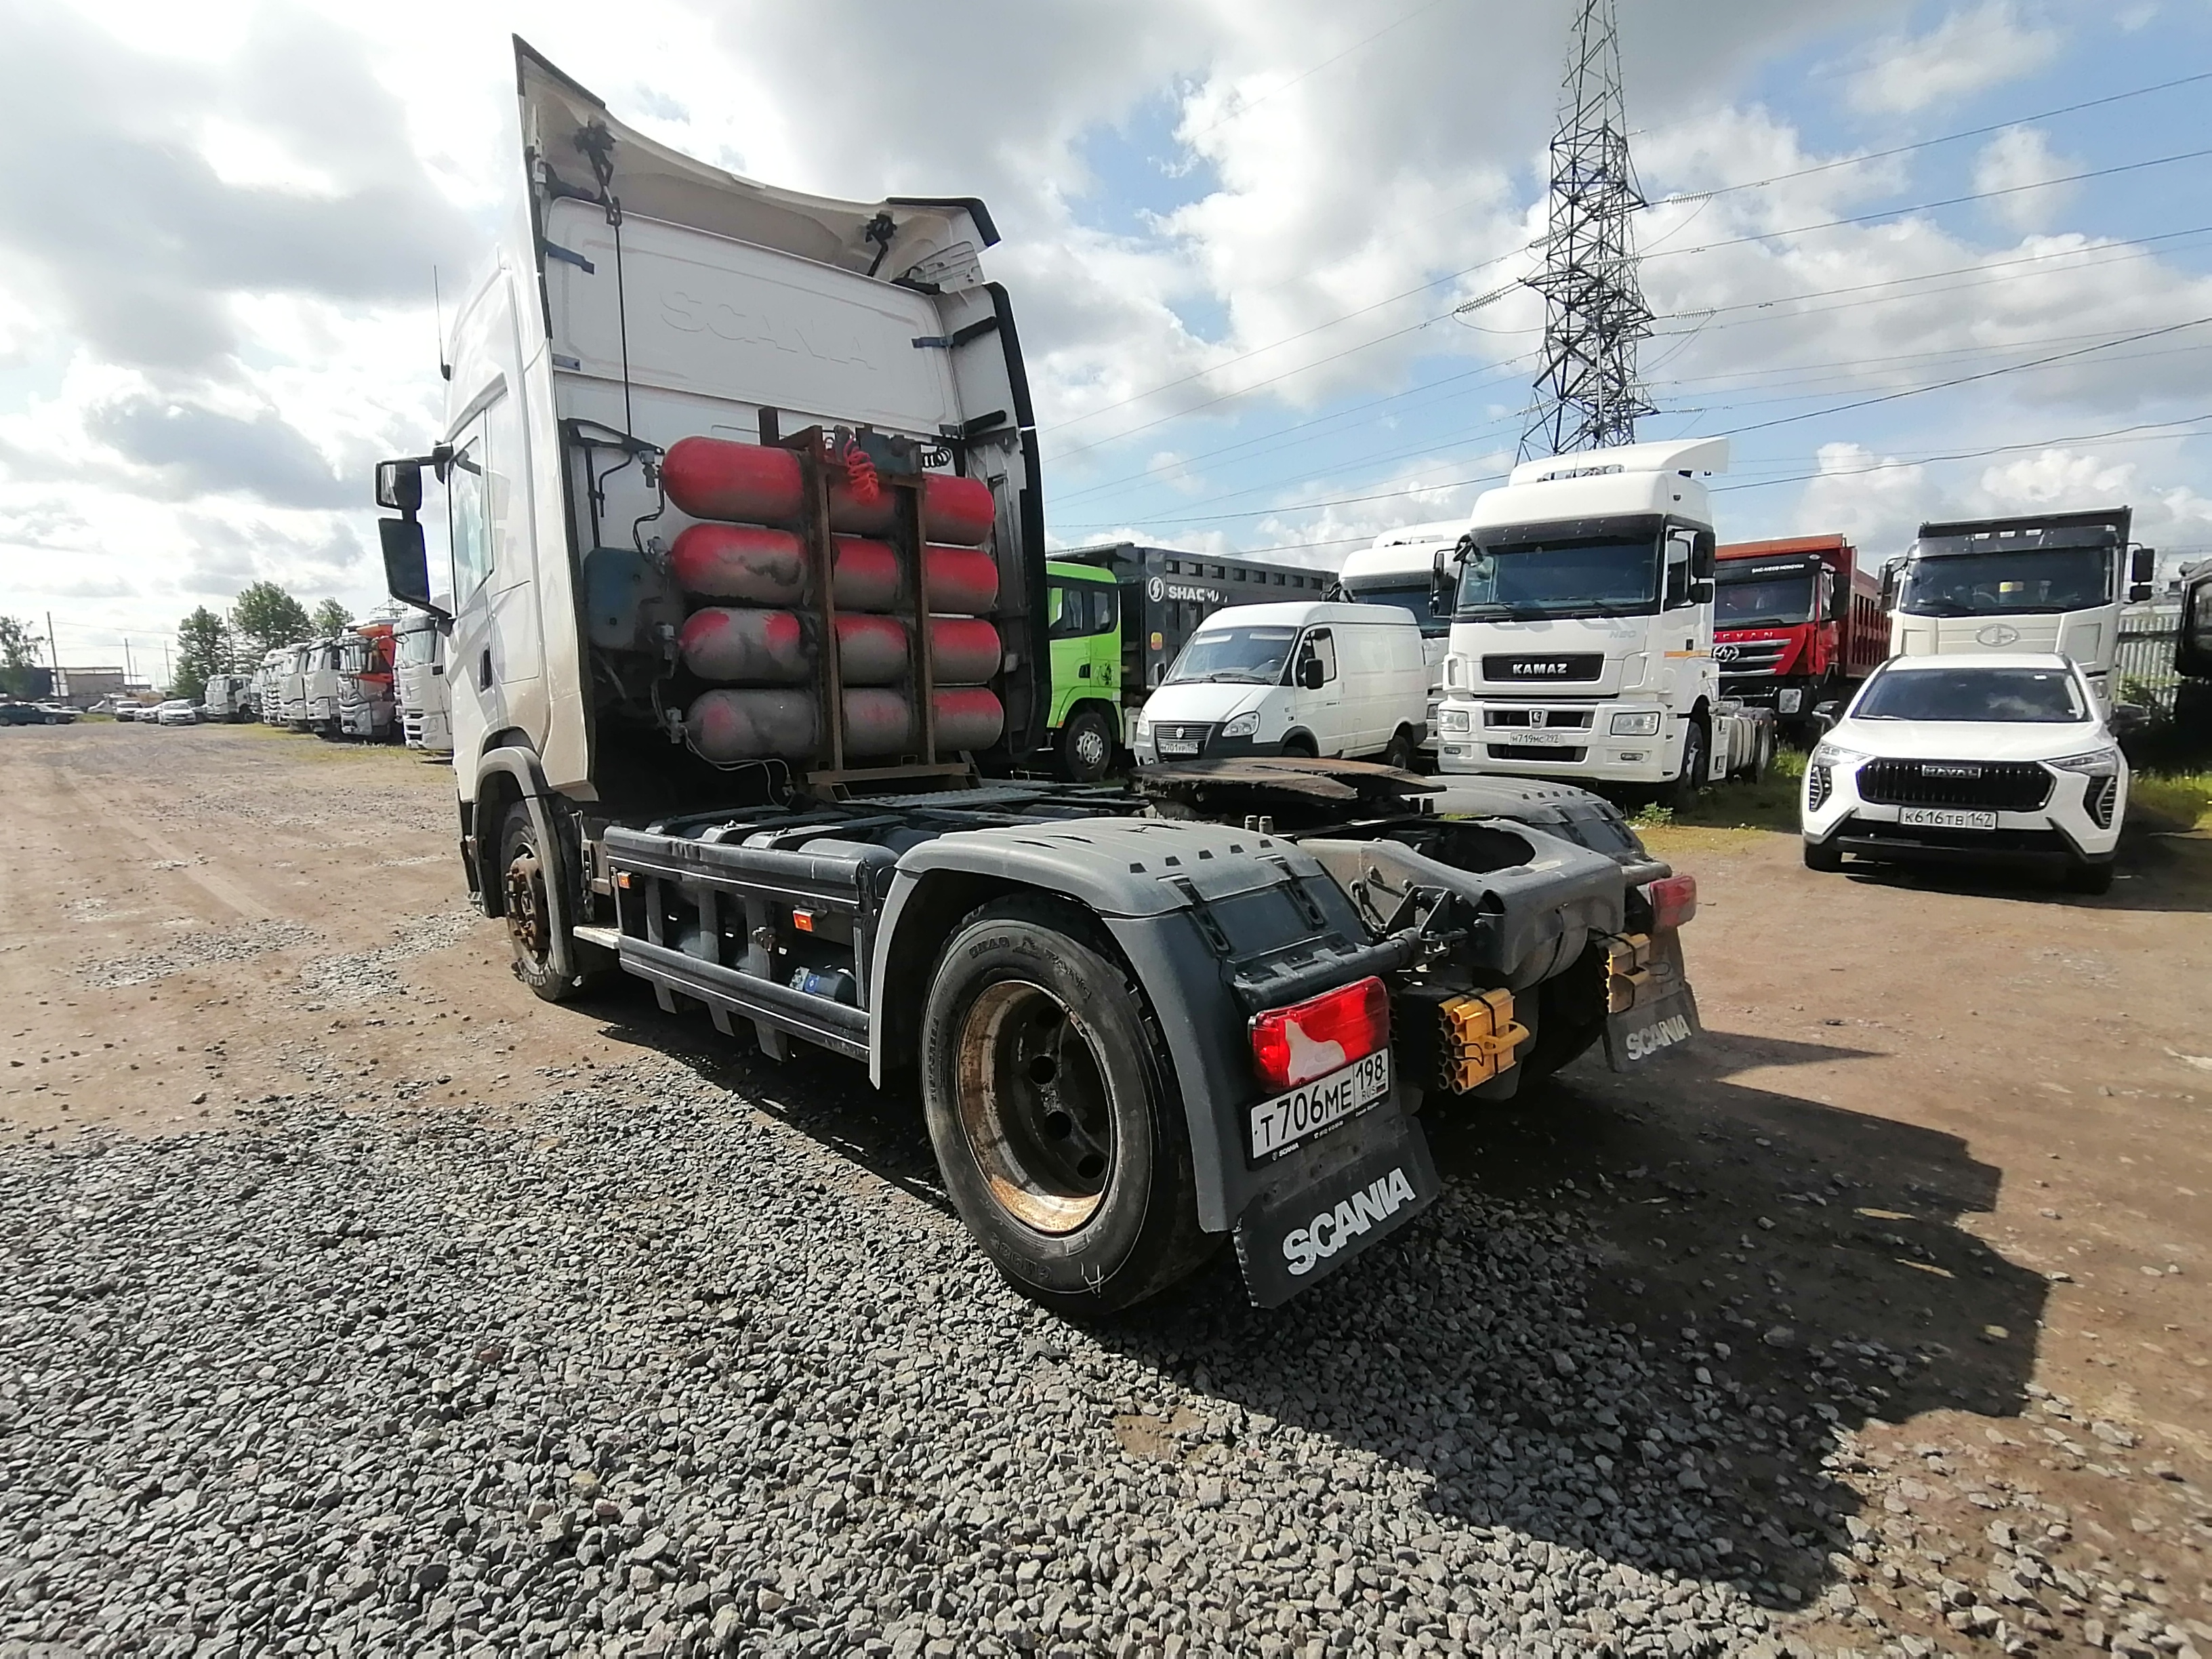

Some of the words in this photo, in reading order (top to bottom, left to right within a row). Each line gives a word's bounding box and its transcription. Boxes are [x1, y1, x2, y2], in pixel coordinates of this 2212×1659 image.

[1608, 630, 1637, 638] NEO
[1512, 663, 1568, 675] KAMAZ
[1925, 767, 1978, 777] HAVAL
[1626, 1014, 1692, 1060] SCANIA
[1261, 1079, 1352, 1147] Т706МЕ
[1355, 1054, 1383, 1090] 198
[1362, 1085, 1376, 1101] RUS
[1283, 1167, 1416, 1275] SCANIA
